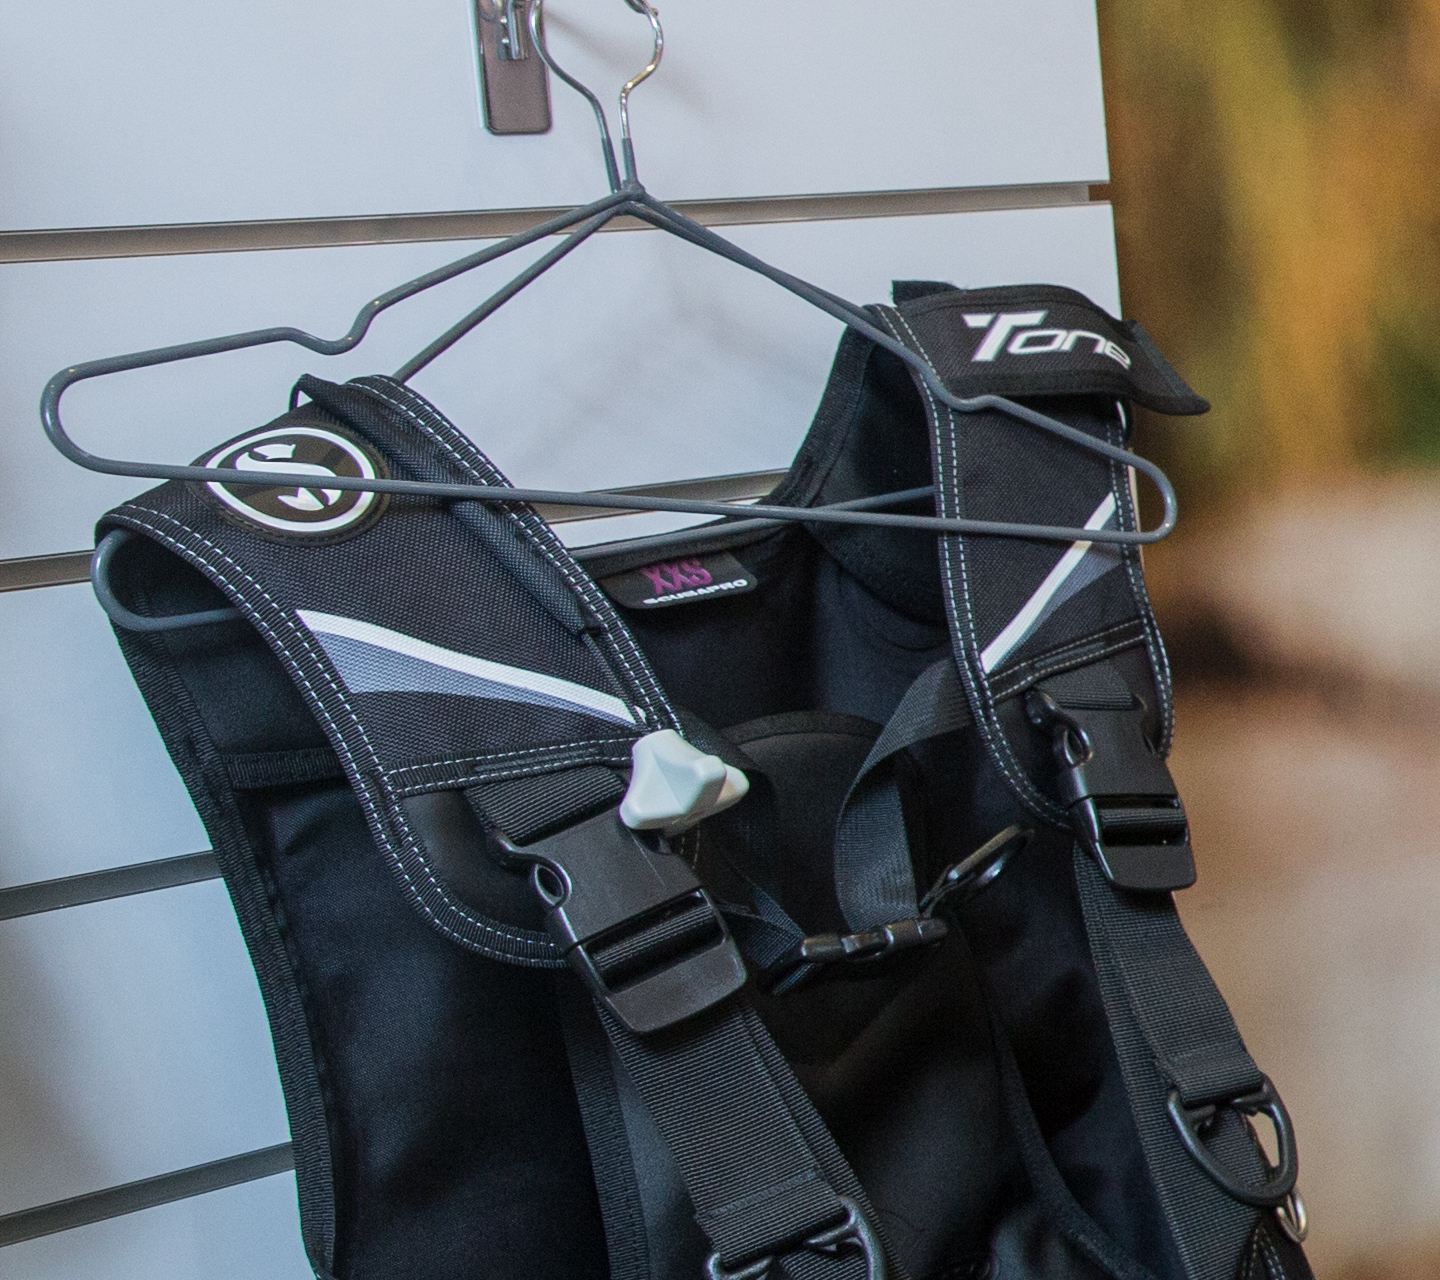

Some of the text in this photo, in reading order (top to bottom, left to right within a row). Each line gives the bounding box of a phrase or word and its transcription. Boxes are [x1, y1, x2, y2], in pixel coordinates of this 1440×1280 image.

[962, 310, 1132, 370] Tone
[641, 557, 713, 595] XXS
[642, 578, 749, 605] SCUBAPRO
